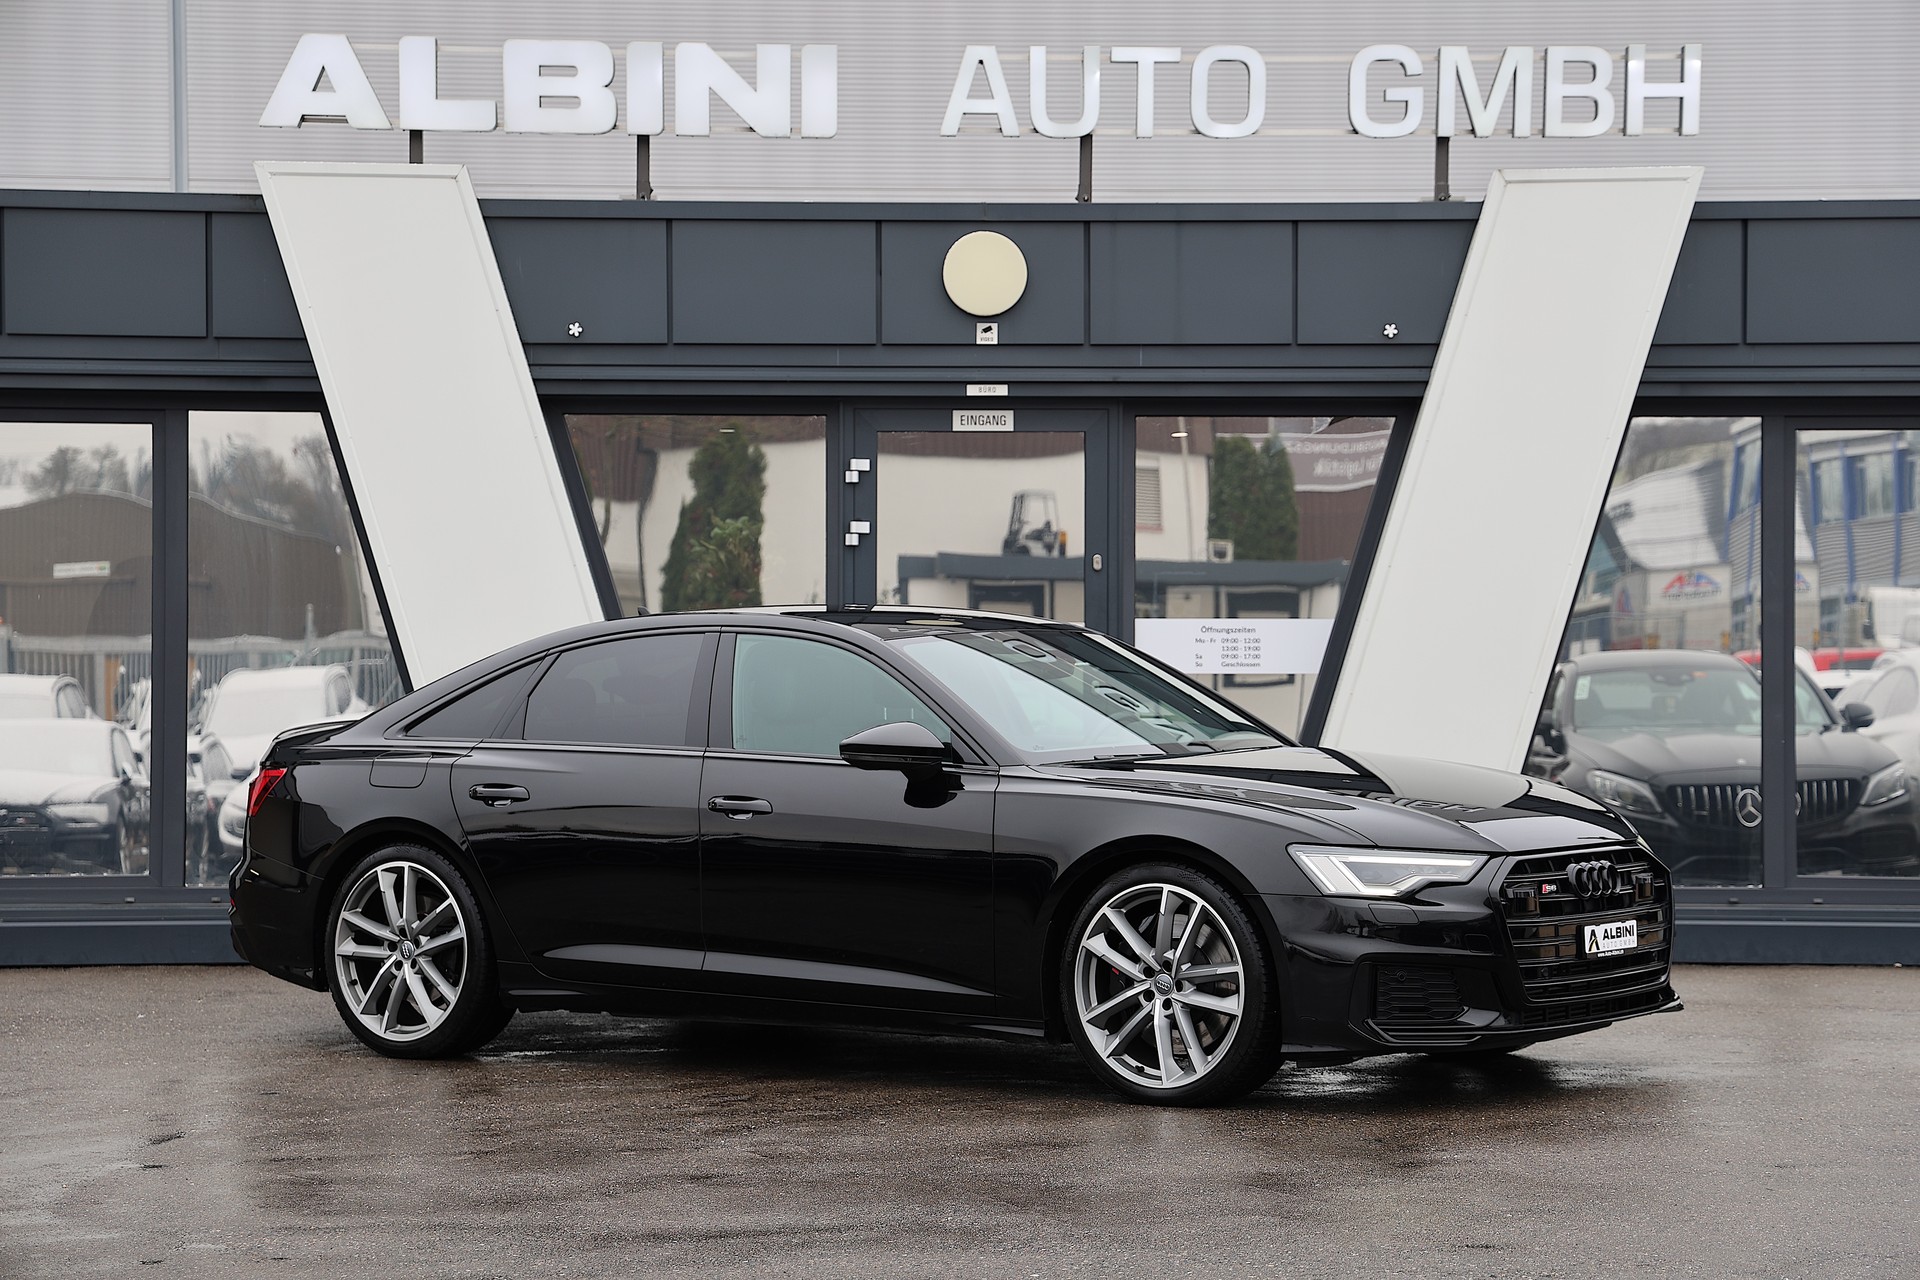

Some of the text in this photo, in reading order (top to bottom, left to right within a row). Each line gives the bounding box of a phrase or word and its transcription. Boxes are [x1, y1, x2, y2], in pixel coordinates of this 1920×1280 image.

[258, 34, 1702, 140] ALBINI AUTO GMBH
[960, 415, 1007, 426] EINGANG
[1200, 625, 1256, 634] Öffnungszeiten
[1602, 925, 1635, 940] ALBINI
